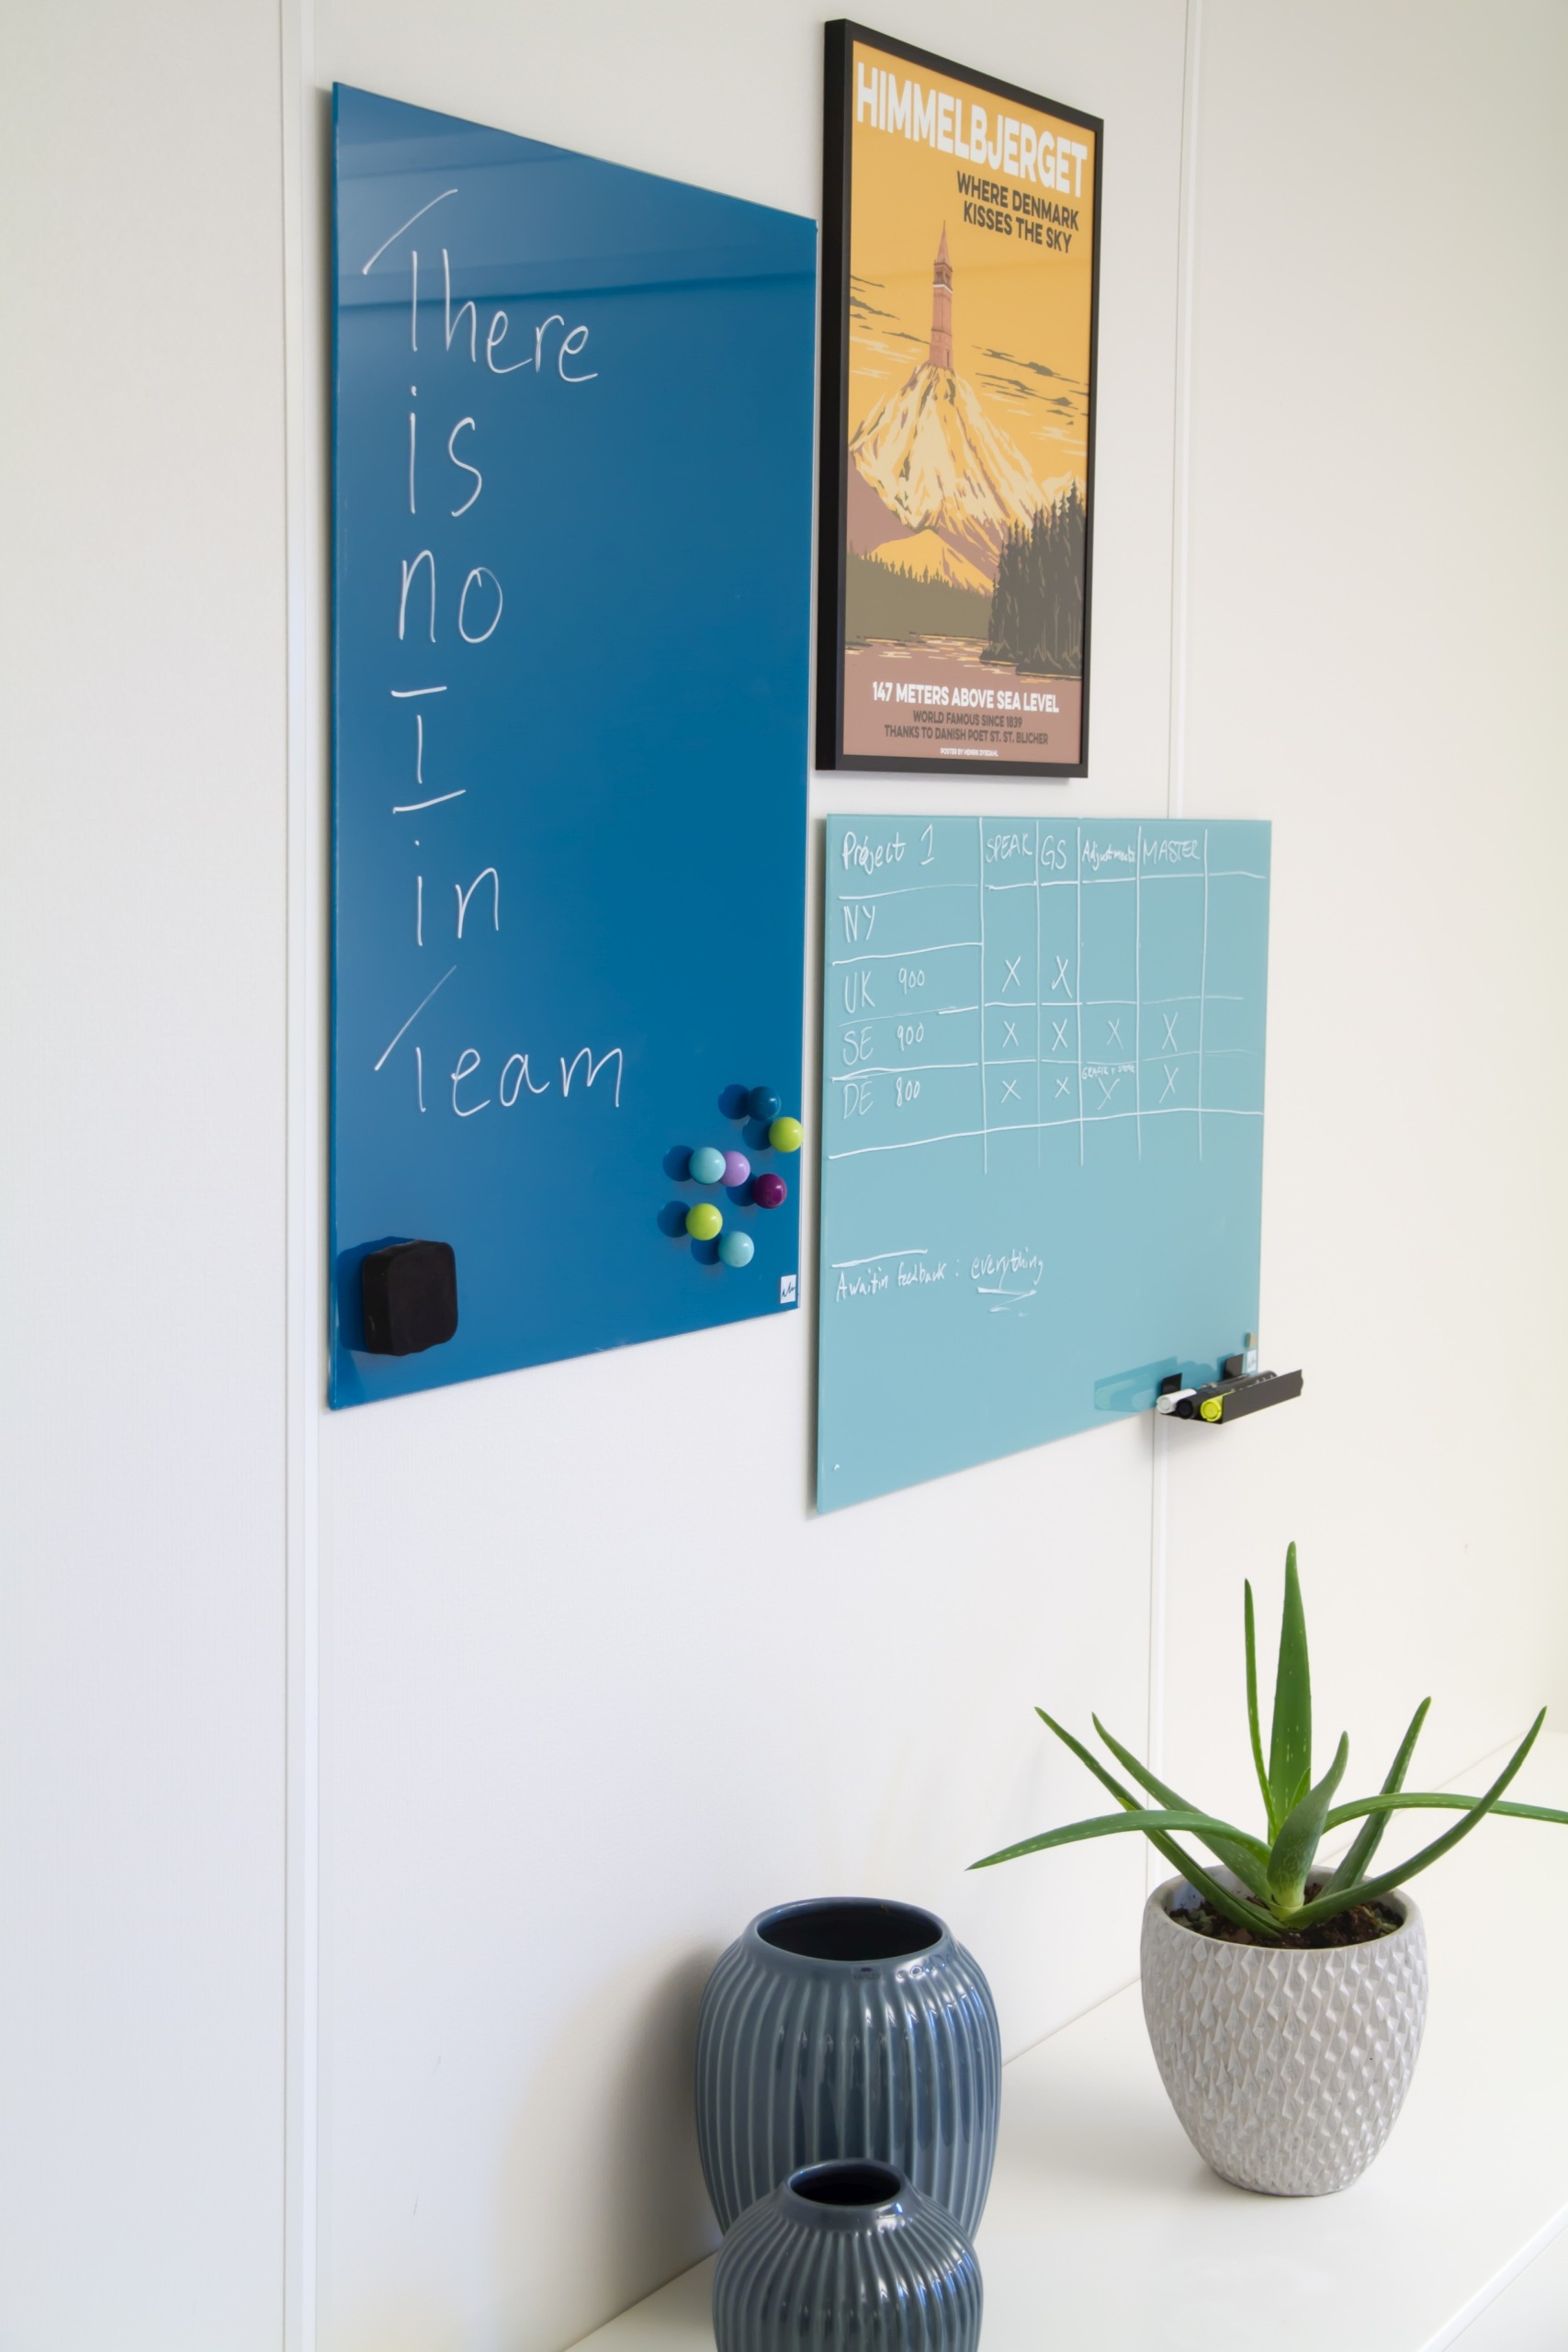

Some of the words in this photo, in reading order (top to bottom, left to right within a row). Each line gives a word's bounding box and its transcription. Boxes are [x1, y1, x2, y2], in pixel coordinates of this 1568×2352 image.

[857, 62, 1088, 198] HIMMELBJERGET
[956, 170, 1009, 209] WHERE
[1012, 189, 1079, 232] DENMARK
[964, 200, 1012, 236] KISSES
[1015, 217, 1043, 245] THE
[1045, 226, 1072, 254] SKY
[363, 189, 599, 383] There
[410, 386, 483, 516] is
[399, 550, 503, 643] no
[873, 681, 893, 702] 147
[896, 683, 949, 706] METERS
[951, 687, 995, 708] ABOVE
[997, 690, 1021, 710] SEA
[1023, 692, 1059, 713] LEVEL
[885, 724, 919, 739] THANKS
[921, 727, 933, 740] TO
[935, 728, 966, 741] DANISH
[968, 729, 988, 742] POET
[990, 730, 1001, 743] ST.
[1003, 731, 1015, 743] ST.
[1016, 732, 1049, 745] BLICHER
[913, 710, 944, 724] WORLD
[946, 712, 980, 727] FAMOUS
[982, 715, 1005, 728] SINCE
[1006, 716, 1022, 729] 1839
[390, 685, 467, 814] I
[940, 747, 957, 755] POSTER
[920, 824, 935, 865] 1
[1041, 835, 1066, 870] GS
[1143, 838, 1201, 864] MASTER
[415, 840, 499, 946] in
[843, 904, 875, 943] NY
[844, 969, 875, 1013] UK
[898, 967, 925, 995] 900
[374, 966, 625, 1117] Team
[842, 1025, 874, 1066] SE
[897, 1023, 924, 1051] 900
[842, 1080, 874, 1119] DE
[896, 1076, 920, 1107] 800
[971, 1248, 1043, 1290] everything
